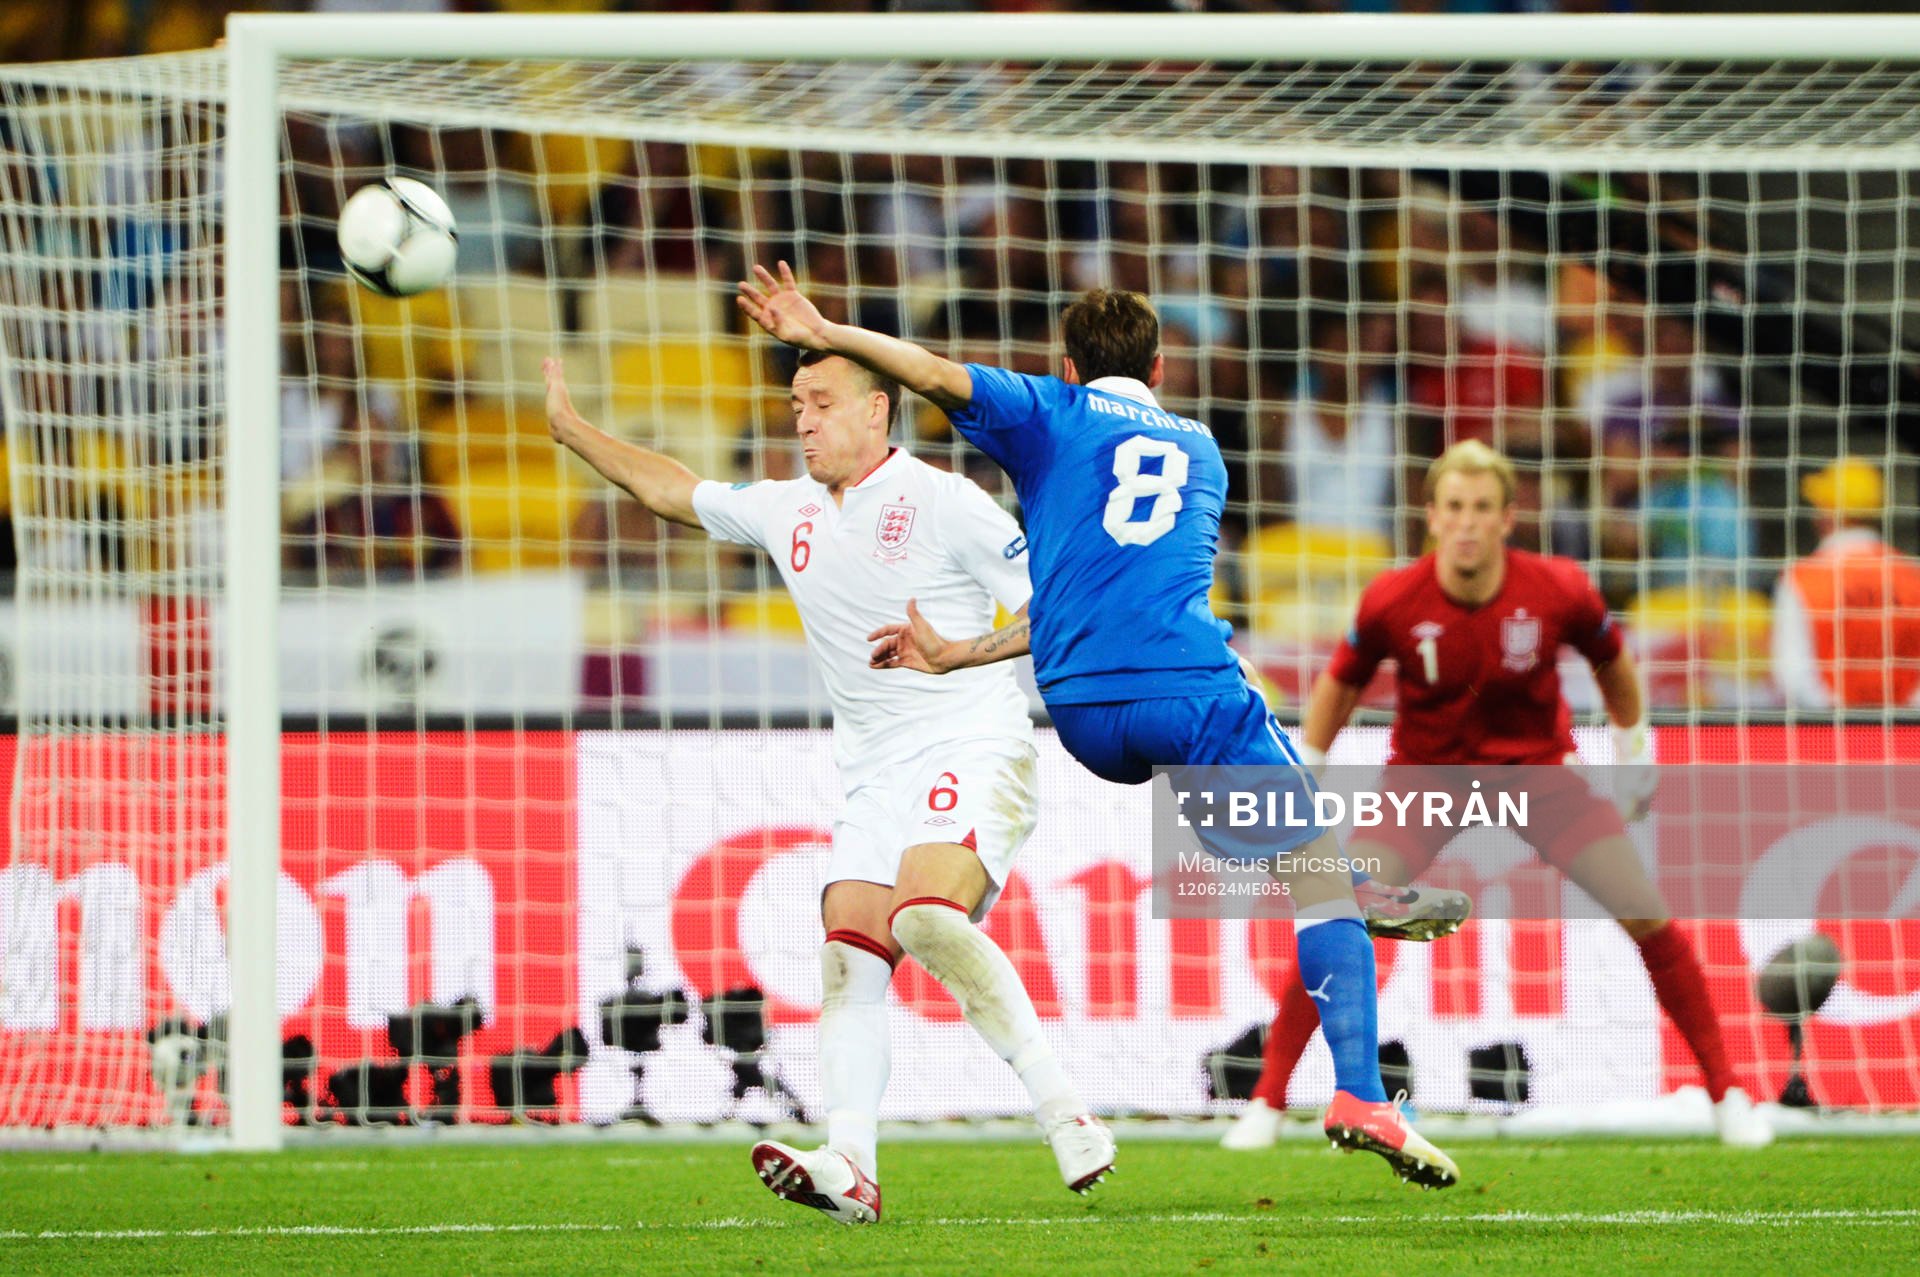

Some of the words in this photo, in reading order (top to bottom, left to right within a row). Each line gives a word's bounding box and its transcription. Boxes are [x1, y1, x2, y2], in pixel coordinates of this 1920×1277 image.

[1102, 434, 1190, 547] 8
[790, 521, 814, 573] 6
[1416, 638, 1439, 685] 1
[928, 771, 959, 812] 6
